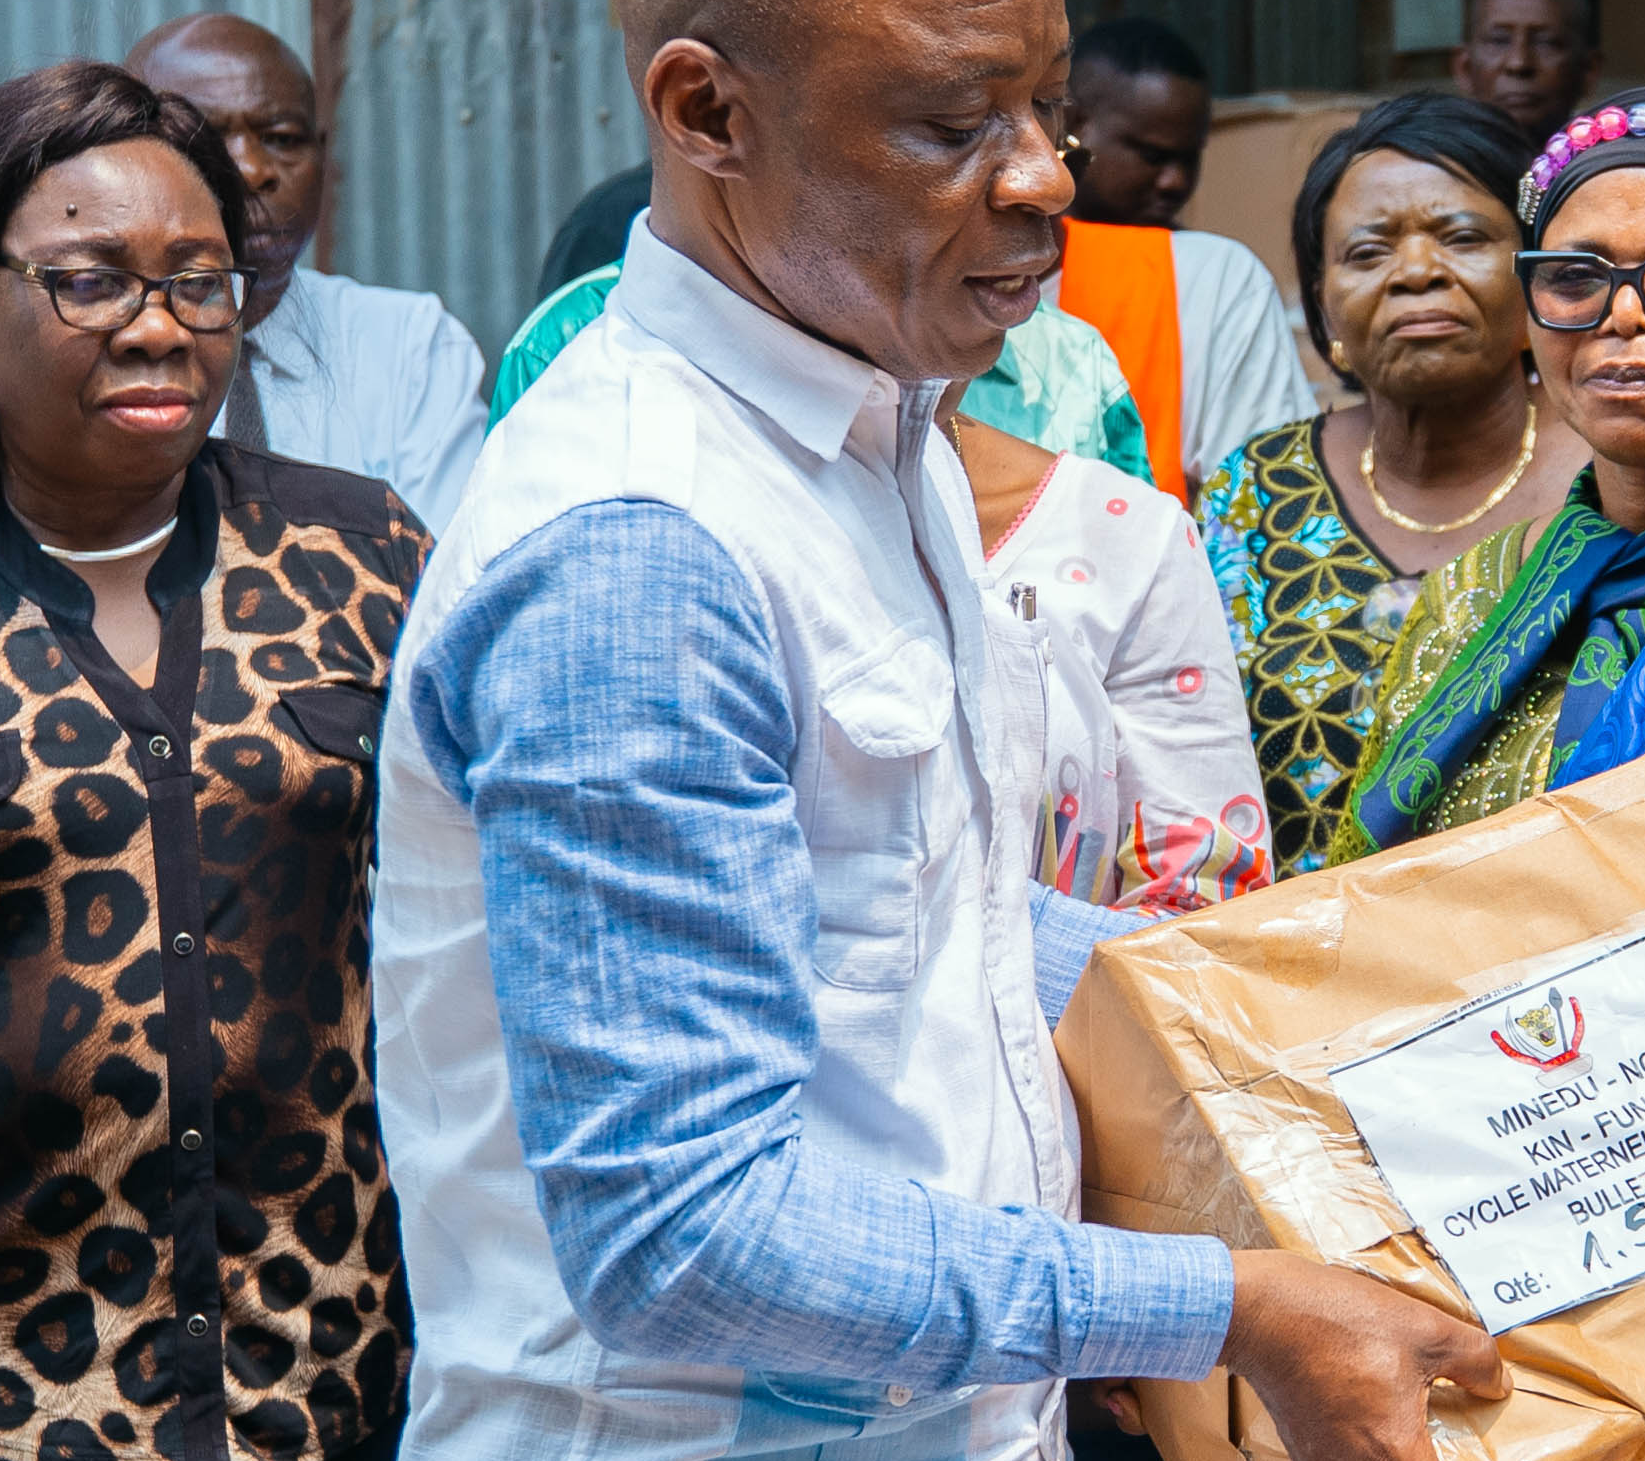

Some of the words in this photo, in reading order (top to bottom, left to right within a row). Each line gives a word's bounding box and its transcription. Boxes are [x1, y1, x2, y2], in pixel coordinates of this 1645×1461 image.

[1486, 1075, 1599, 1138] MINEDU
[1522, 1129, 1576, 1166] KIN
[1442, 1184, 1530, 1238] CYCLE
